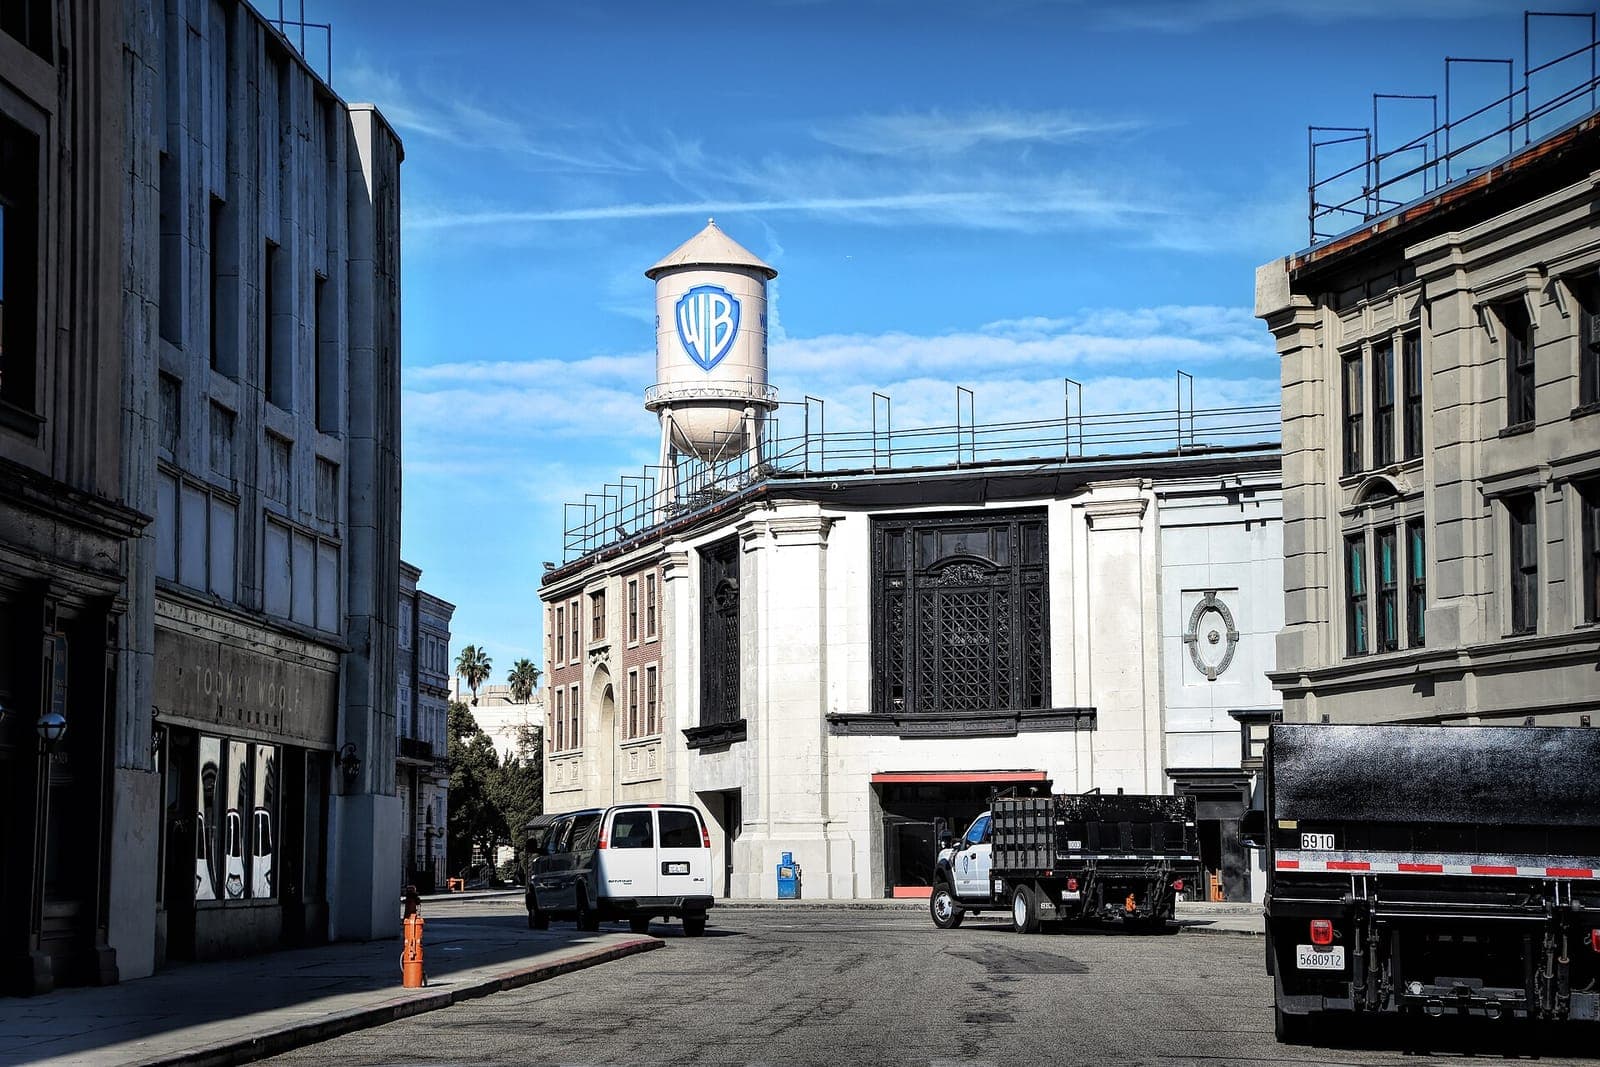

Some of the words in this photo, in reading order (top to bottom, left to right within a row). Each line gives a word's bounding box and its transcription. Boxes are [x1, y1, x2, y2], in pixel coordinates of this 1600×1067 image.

[680, 293, 734, 362] WB
[1302, 834, 1334, 849] 6910
[1300, 953, 1341, 967] 56809T2
